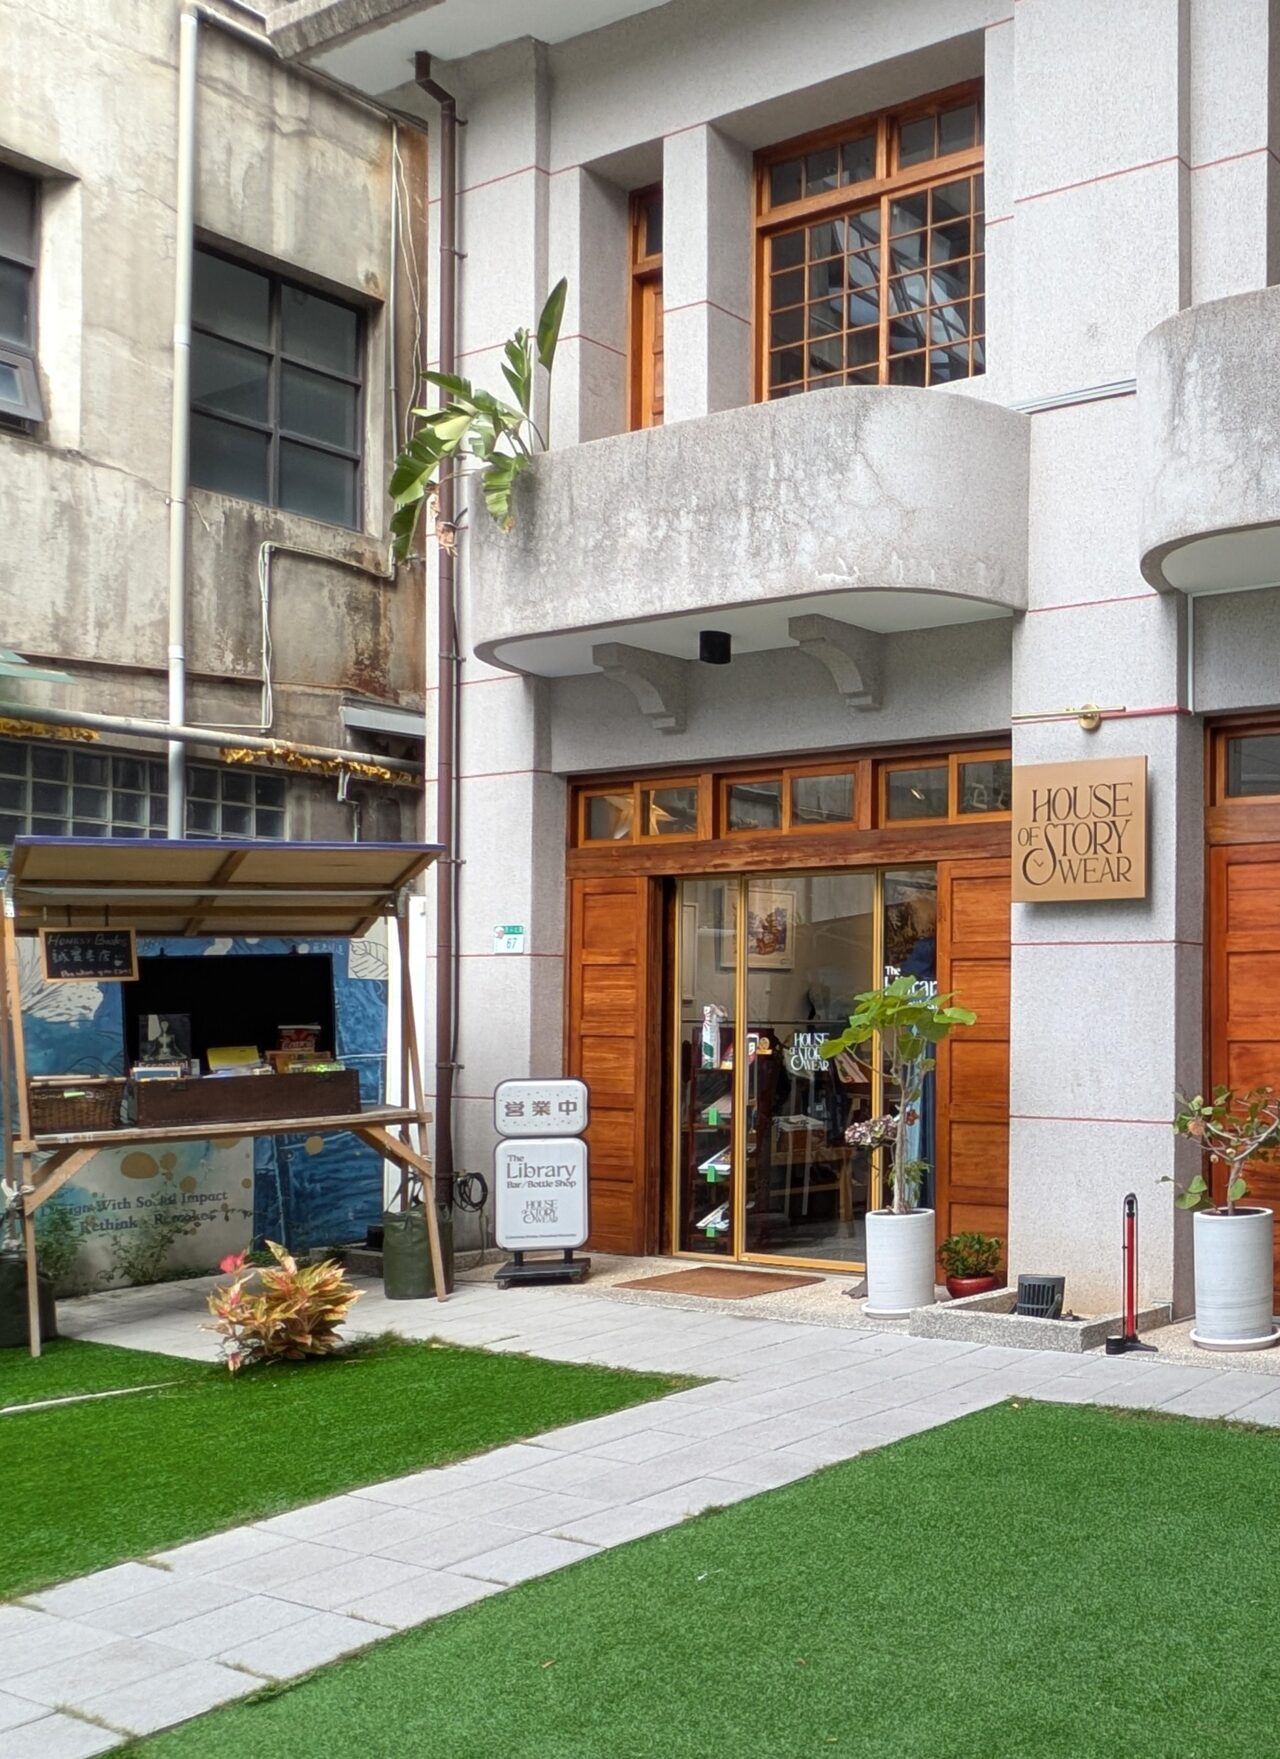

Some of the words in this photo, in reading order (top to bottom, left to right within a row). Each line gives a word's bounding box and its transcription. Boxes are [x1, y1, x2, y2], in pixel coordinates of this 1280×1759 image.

[1032, 782, 1133, 822] HOUSE
[1017, 826, 1041, 847] OF
[1022, 819, 1131, 886] STORY
[1058, 856, 1132, 884] WEAR
[506, 937, 518, 949] 67
[885, 965, 901, 976] The
[791, 1046, 824, 1071] STOR
[803, 1060, 829, 1071] WEAR
[507, 1154, 524, 1163] The
[506, 1162, 576, 1182] Library
[555, 1179, 577, 1188] Shop
[96, 1197, 131, 1212] With
[181, 1190, 228, 1206] Impact
[525, 1199, 558, 1210] HOUSE
